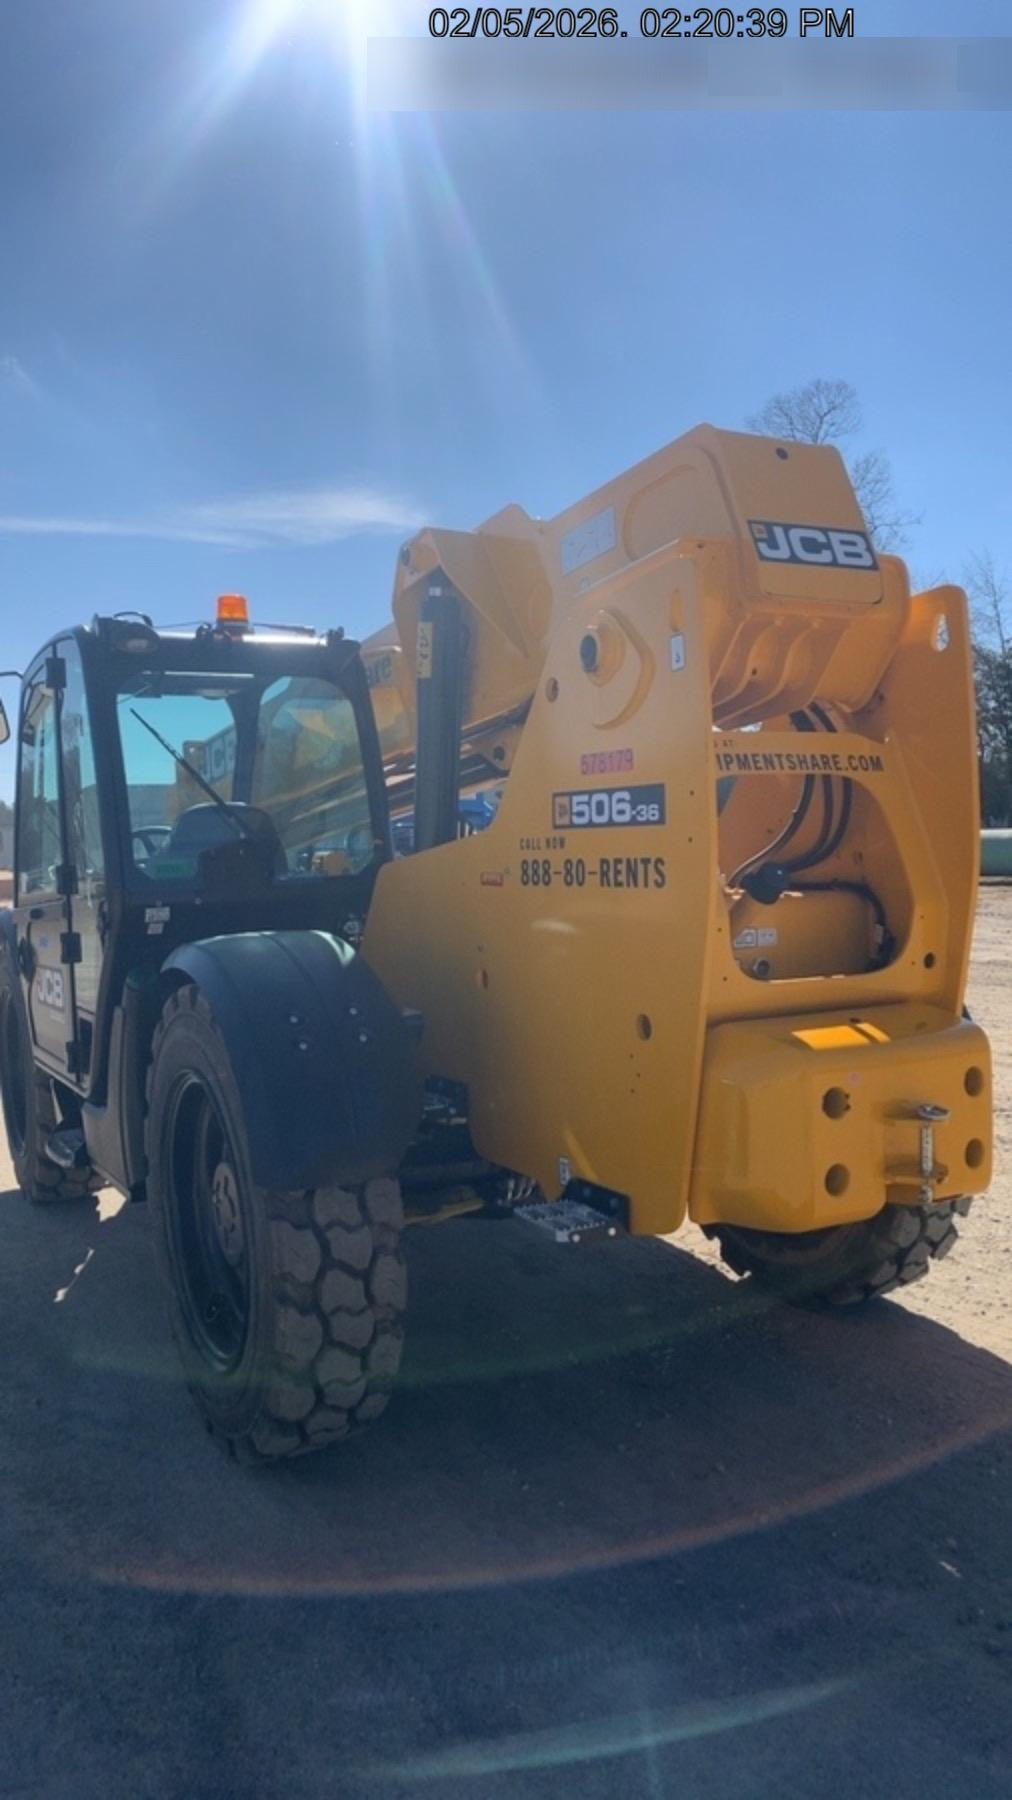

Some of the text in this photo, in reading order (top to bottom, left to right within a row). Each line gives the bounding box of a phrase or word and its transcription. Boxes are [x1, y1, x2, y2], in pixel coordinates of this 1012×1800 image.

[757, 525, 874, 567] JCB
[519, 836, 566, 851] CALL NOW
[520, 857, 667, 889] 888-80-RENTS
[37, 967, 64, 1009] JCB
